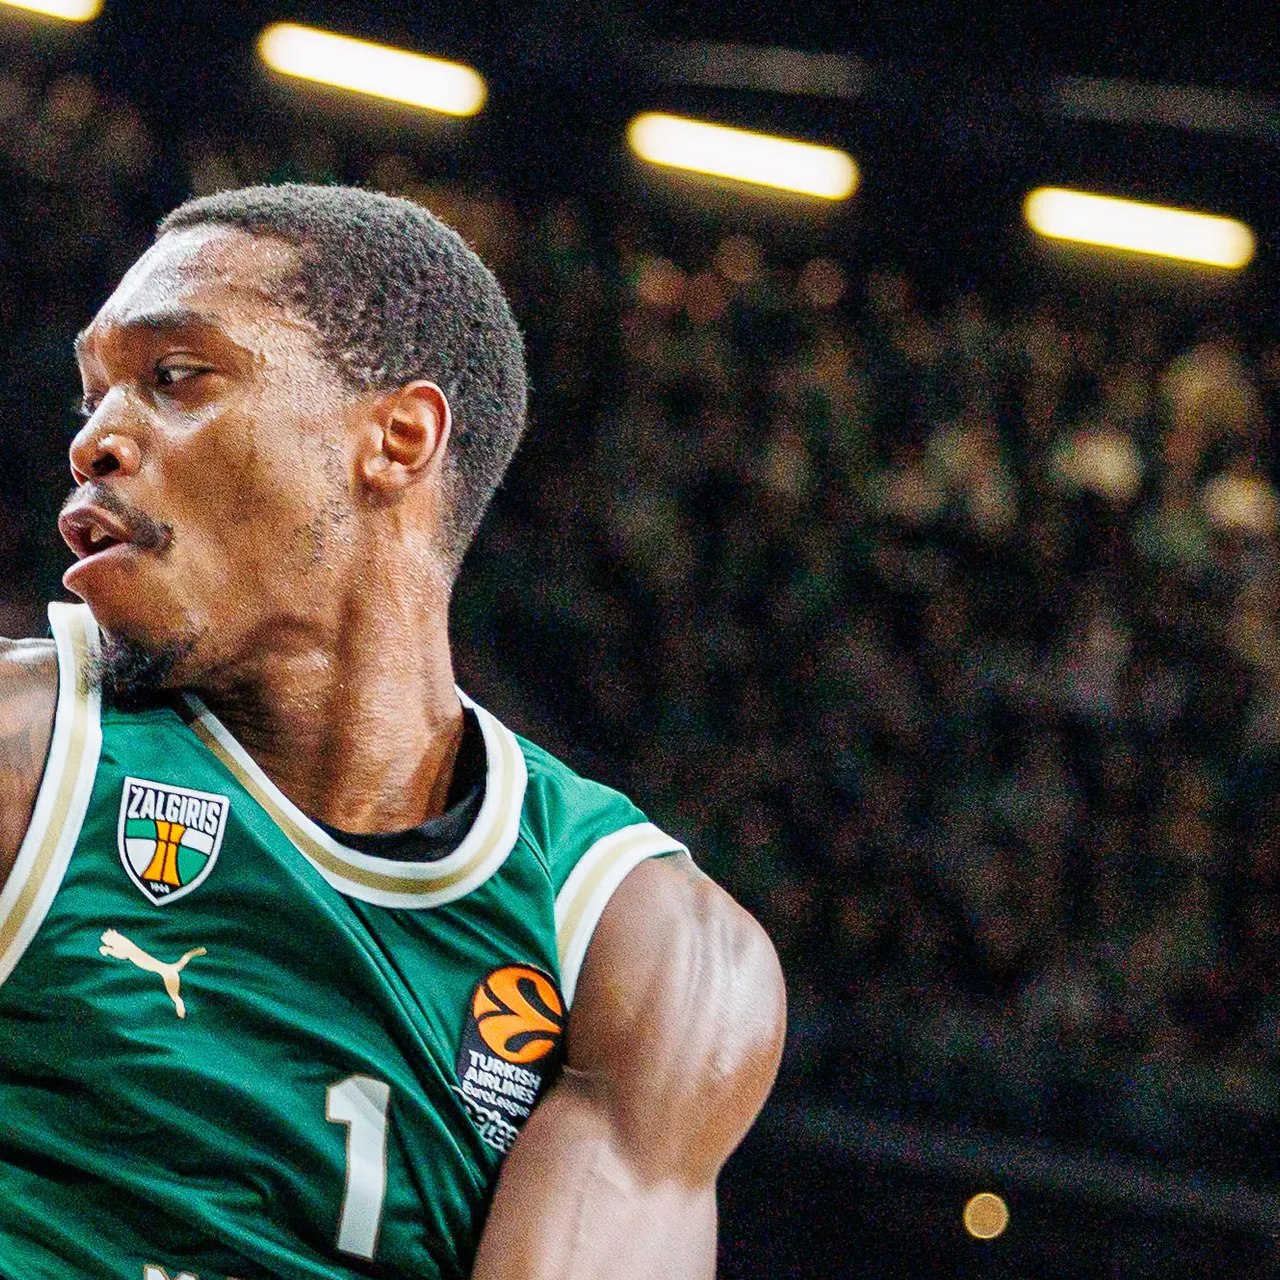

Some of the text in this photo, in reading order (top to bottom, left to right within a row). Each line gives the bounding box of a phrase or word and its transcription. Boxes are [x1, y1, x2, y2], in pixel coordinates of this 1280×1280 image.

[464, 1066, 536, 1104] AIRLINES
[468, 1049, 541, 1090] TURKISH
[326, 1073, 390, 1262] 1
